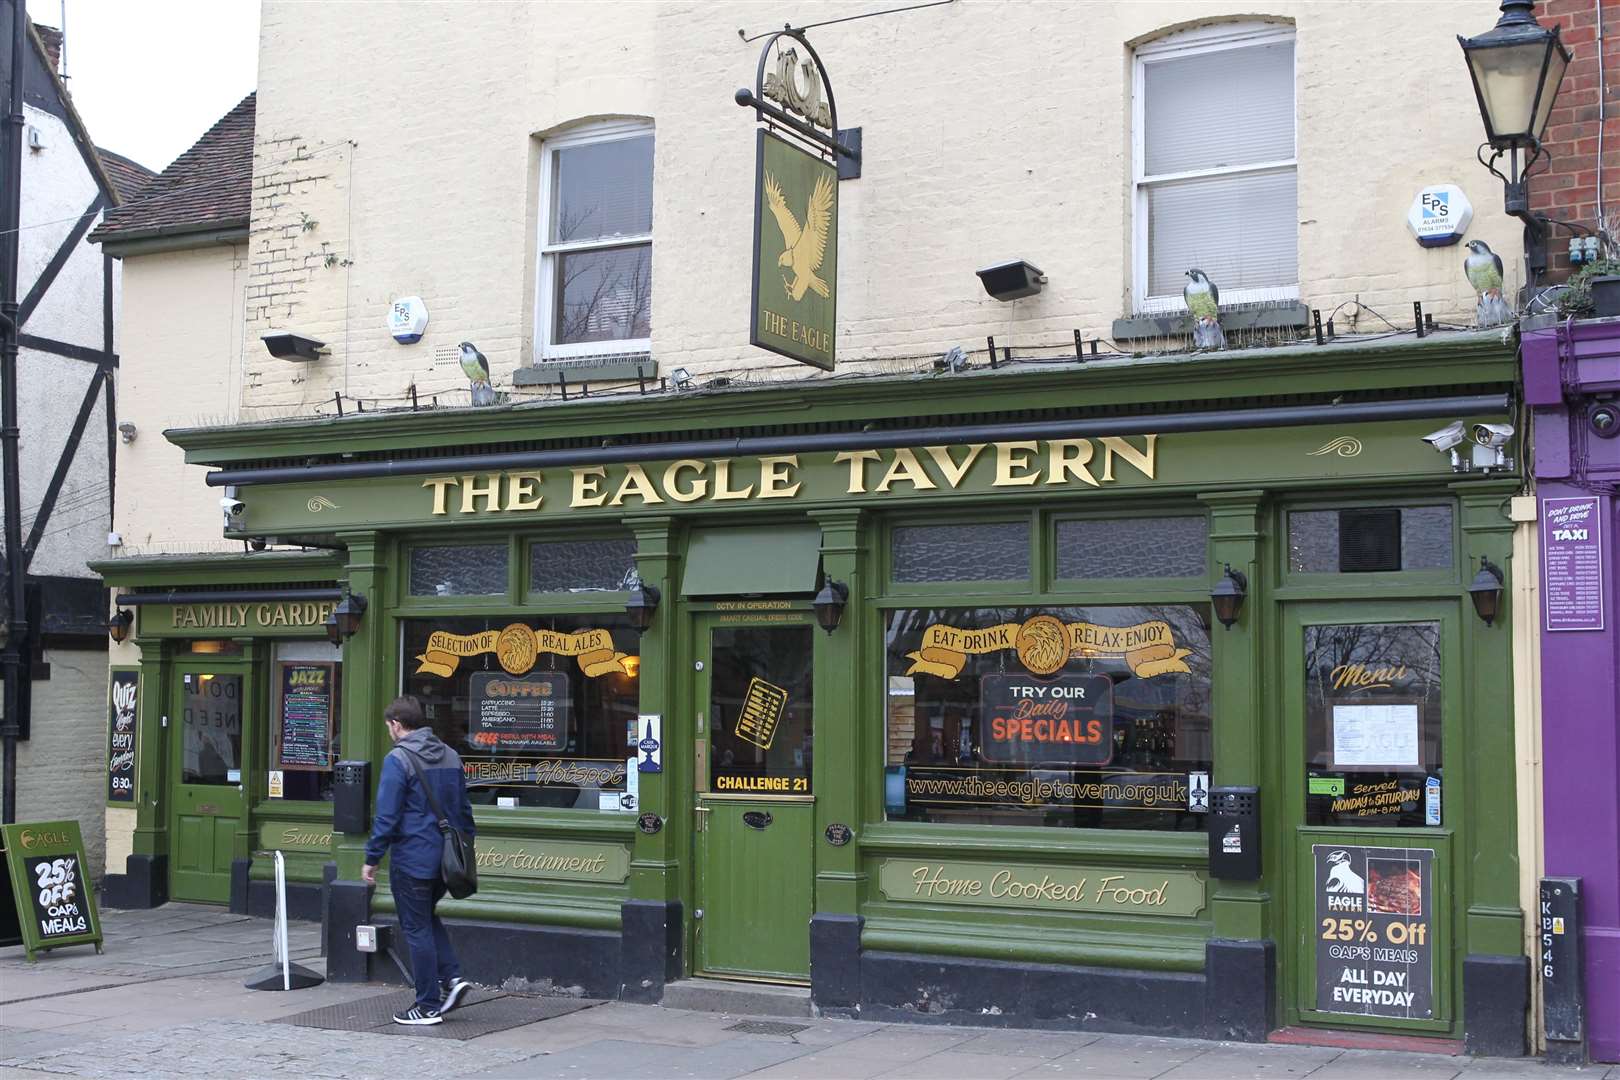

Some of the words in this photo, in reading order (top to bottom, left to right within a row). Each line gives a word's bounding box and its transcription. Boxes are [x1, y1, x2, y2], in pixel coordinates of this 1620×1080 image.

[1422, 193, 1449, 216] EPS
[394, 303, 410, 321] EPS
[763, 310, 788, 336] THE
[792, 321, 830, 353] EAGLE
[422, 470, 544, 515] THE
[570, 454, 801, 508] EAGLE
[833, 434, 1159, 493] TAVERN
[1553, 515, 1569, 523] AND
[1569, 511, 1590, 520] DRIVE
[1568, 503, 1593, 513] DRINK
[1552, 529, 1588, 540] TAXI
[173, 603, 250, 628] FAMILY
[256, 602, 337, 626] GARDE
[716, 602, 735, 610] CCTV
[747, 601, 792, 609] OPERATION
[431, 635, 479, 652] SELECTION
[480, 635, 492, 649] OF
[542, 635, 569, 651] REAL
[573, 632, 602, 650] ALES
[289, 671, 325, 686] JAZZ
[1330, 662, 1407, 690] Menu
[1010, 686, 1046, 699] TRY
[1051, 686, 1085, 699] OUR
[1013, 699, 1069, 721] Daily
[474, 732, 498, 744] FREE
[991, 717, 1102, 743] SPECIALS
[113, 734, 132, 750] every
[464, 762, 531, 781] NTERNET
[535, 760, 624, 785] Hotspot
[717, 776, 789, 790] CHALLENGE
[793, 777, 808, 790] 21
[908, 776, 1186, 806] www.theeagletavern.org.uk
[1353, 780, 1397, 794] Served
[1331, 796, 1368, 812] MONDAY
[1375, 788, 1420, 806] SATURDAY
[475, 846, 608, 873] ntertainment
[35, 858, 75, 889] 25%
[39, 882, 76, 906] OFF
[912, 865, 983, 898] Home
[989, 869, 1086, 906] Cooked
[1096, 875, 1168, 906] Food
[1328, 895, 1362, 907] EAGLE
[42, 916, 87, 935] MEALS
[1322, 918, 1378, 943] 25%
[1386, 921, 1426, 945] Off
[1329, 945, 1371, 960] OAP'S
[1374, 947, 1418, 964] MEALS
[1341, 968, 1368, 984] ALL
[1374, 970, 1406, 987] DAY
[1333, 987, 1415, 1007] EVERYDAY
